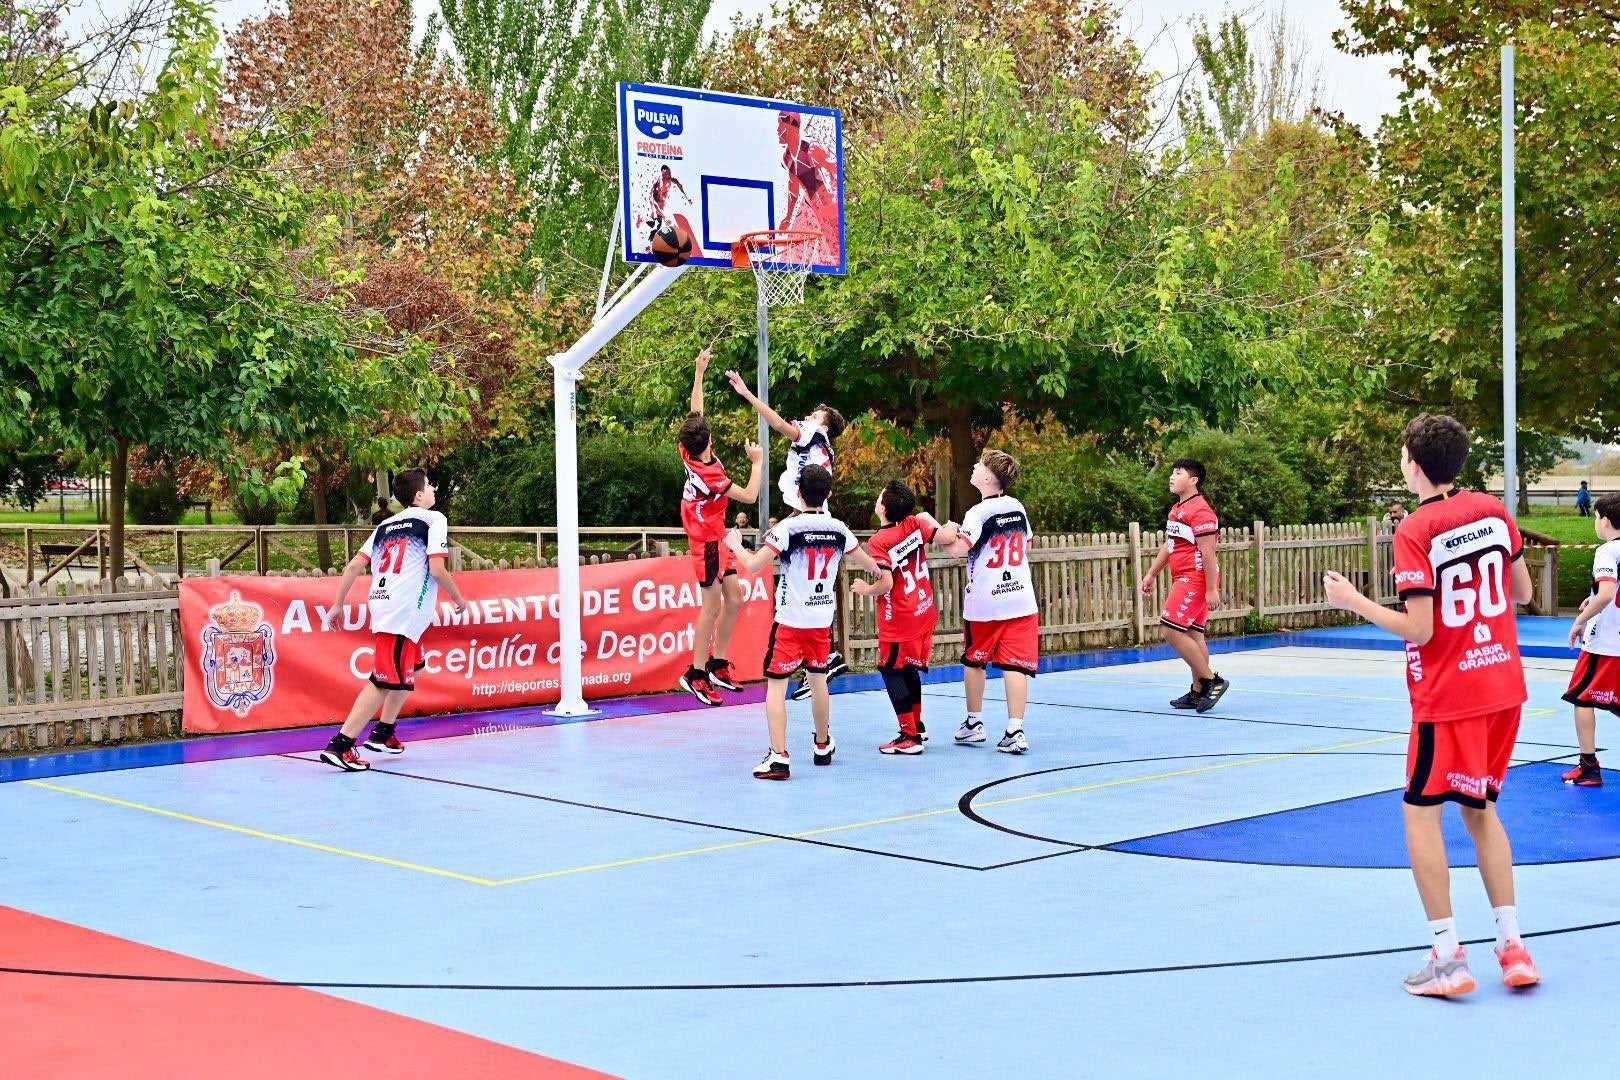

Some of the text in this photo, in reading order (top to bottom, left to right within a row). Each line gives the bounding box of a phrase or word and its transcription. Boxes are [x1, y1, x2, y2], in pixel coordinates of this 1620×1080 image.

[637, 108, 680, 126] PULEVA
[804, 547, 836, 580] 17
[986, 531, 1024, 568] 38
[898, 548, 930, 595] 54
[996, 581, 1019, 590] SABOR
[281, 576, 768, 634] AYUMIENT DE GRADA
[991, 585, 1025, 596] GRANADA
[1441, 550, 1507, 628] 60
[350, 633, 538, 680] Ccejalía
[597, 622, 698, 664] Deport
[1405, 642, 1423, 682] LEVA
[1465, 643, 1503, 660] SABOR
[472, 671, 631, 697] http://deportes.nada.org
[1451, 779, 1479, 795] Digital
